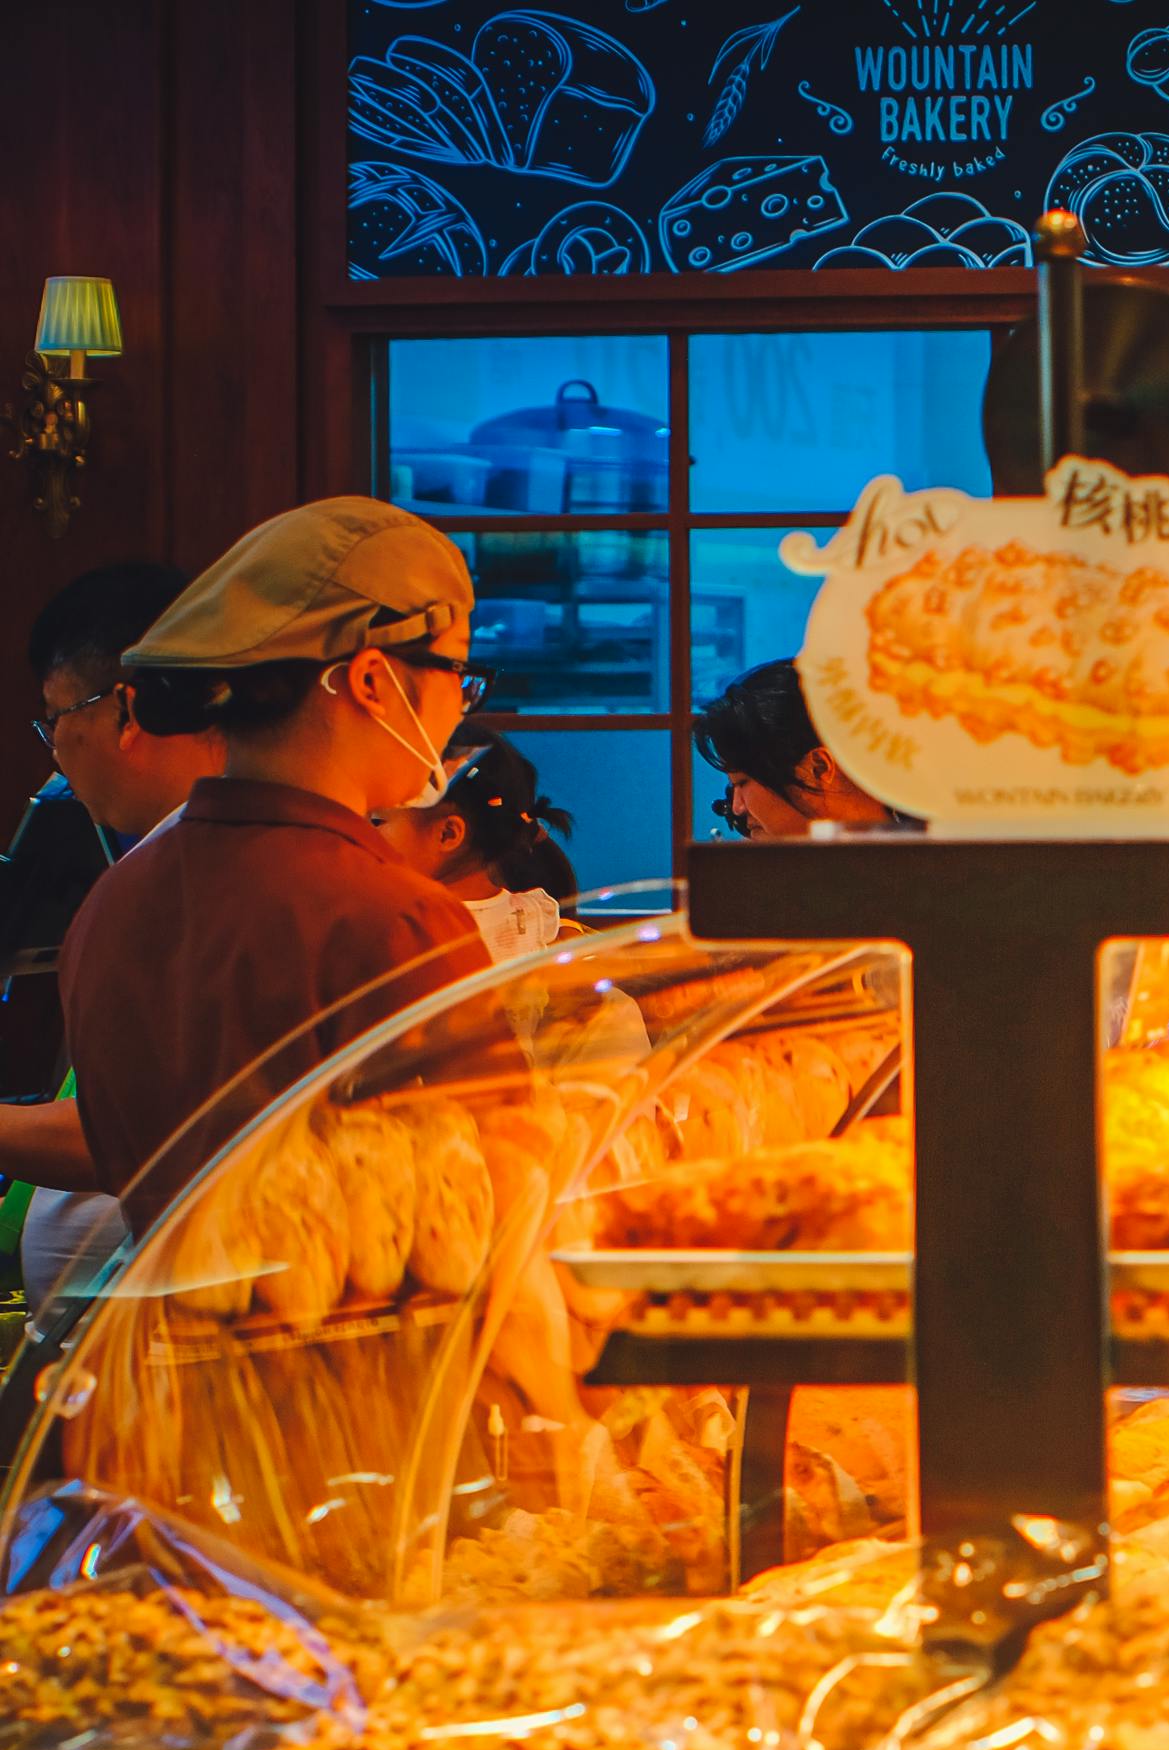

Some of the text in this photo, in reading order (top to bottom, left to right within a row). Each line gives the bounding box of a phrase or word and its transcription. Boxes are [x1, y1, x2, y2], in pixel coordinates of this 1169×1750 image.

[854, 44, 1033, 92] WOUNTAIN
[880, 95, 1013, 142] BAKERY
[953, 145, 1006, 177] baked
